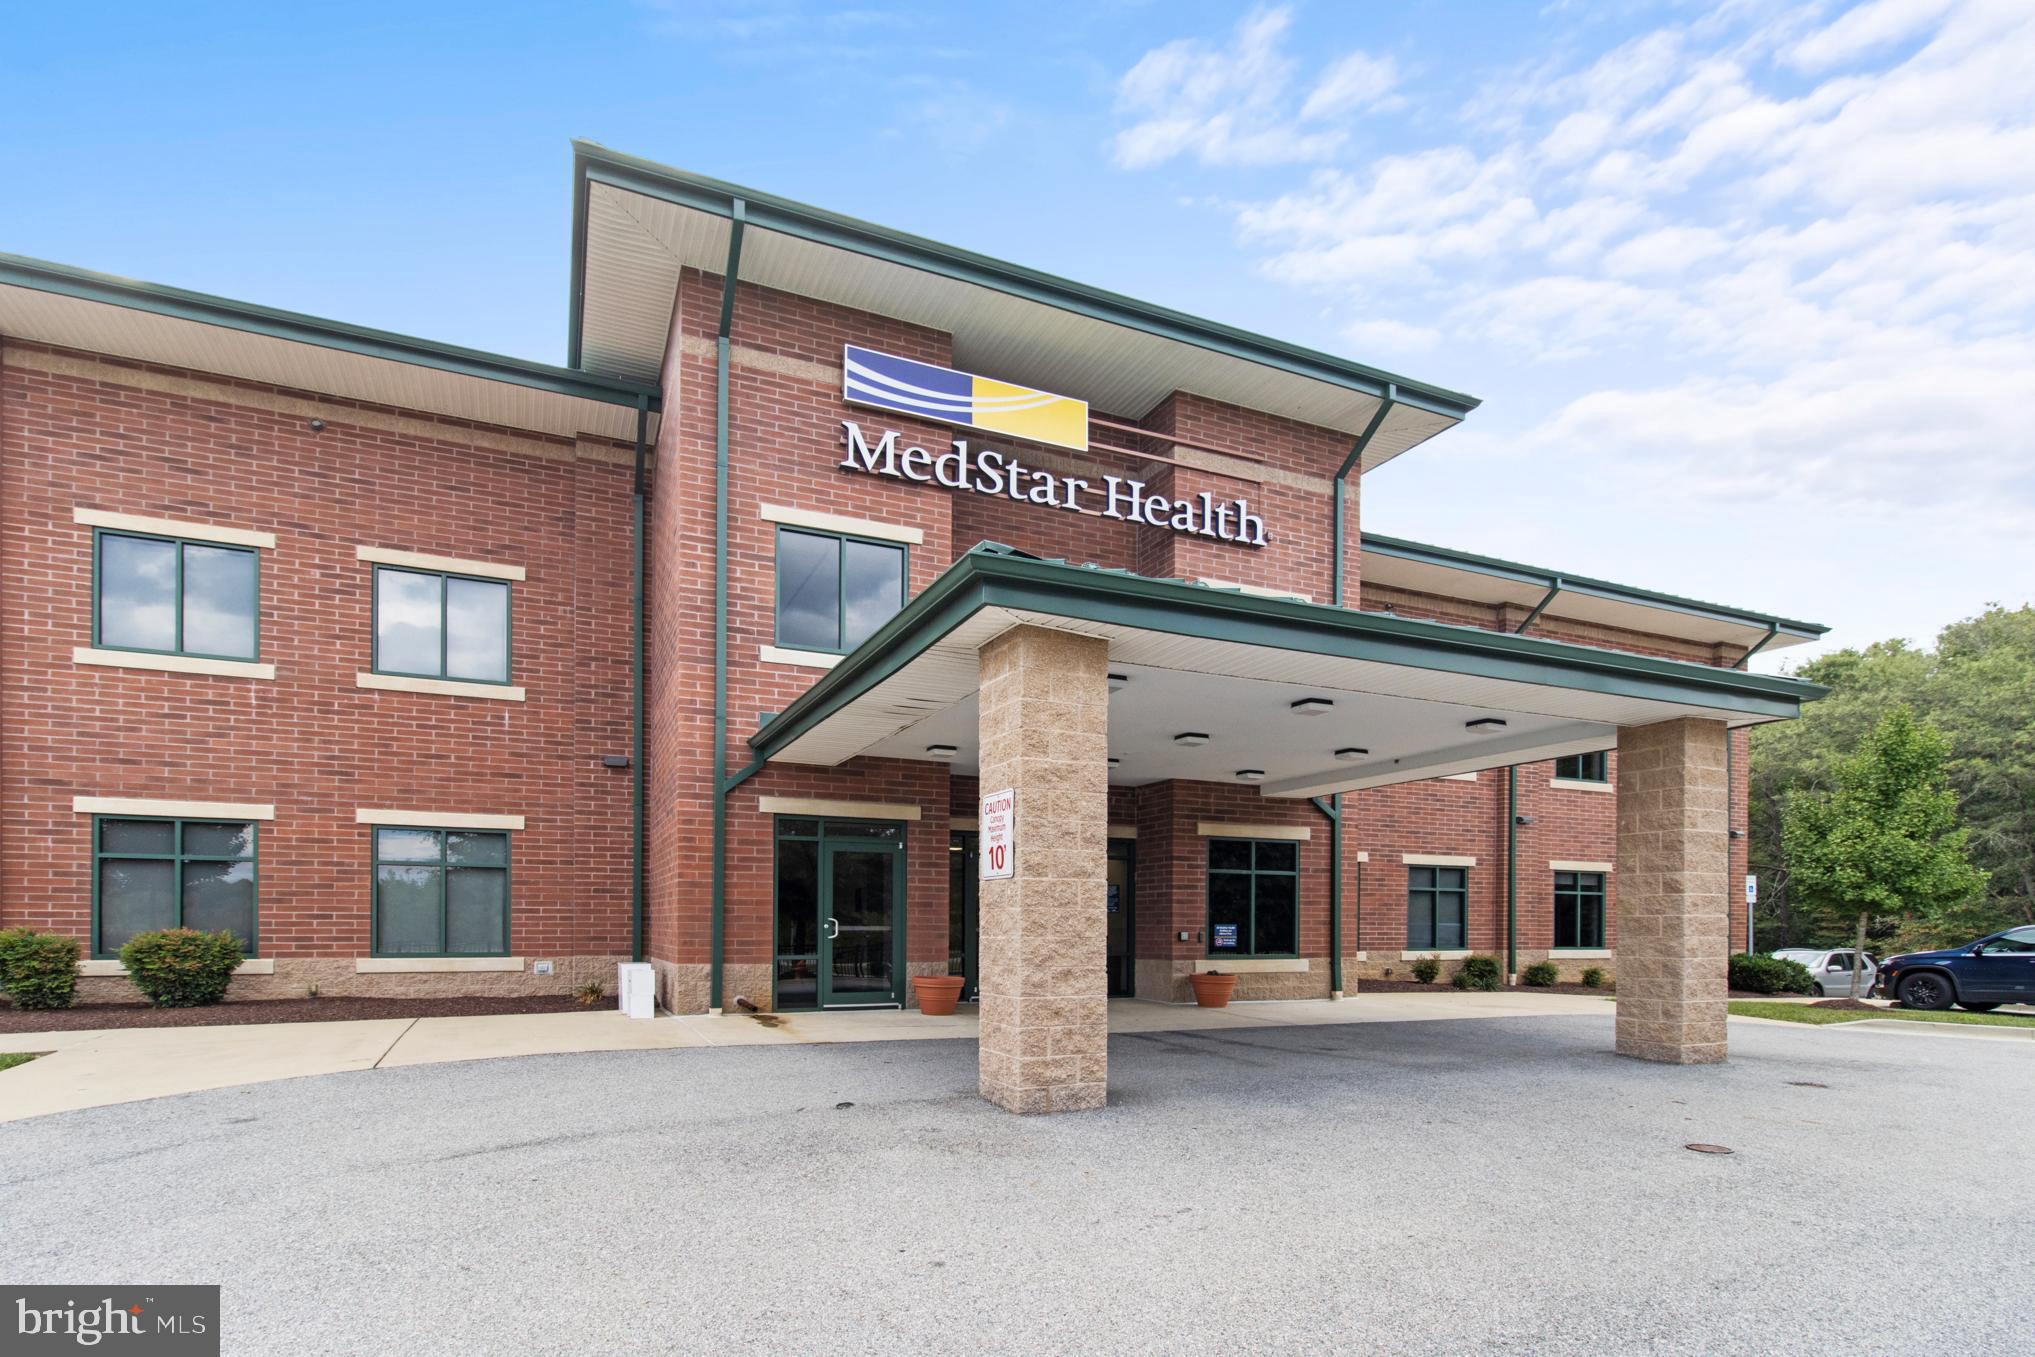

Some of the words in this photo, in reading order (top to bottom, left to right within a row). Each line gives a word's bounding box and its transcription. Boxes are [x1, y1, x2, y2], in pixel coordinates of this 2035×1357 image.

[839, 420, 1088, 512] MedStar
[1101, 474, 1268, 547] Health
[984, 798, 1011, 815] CAUTION
